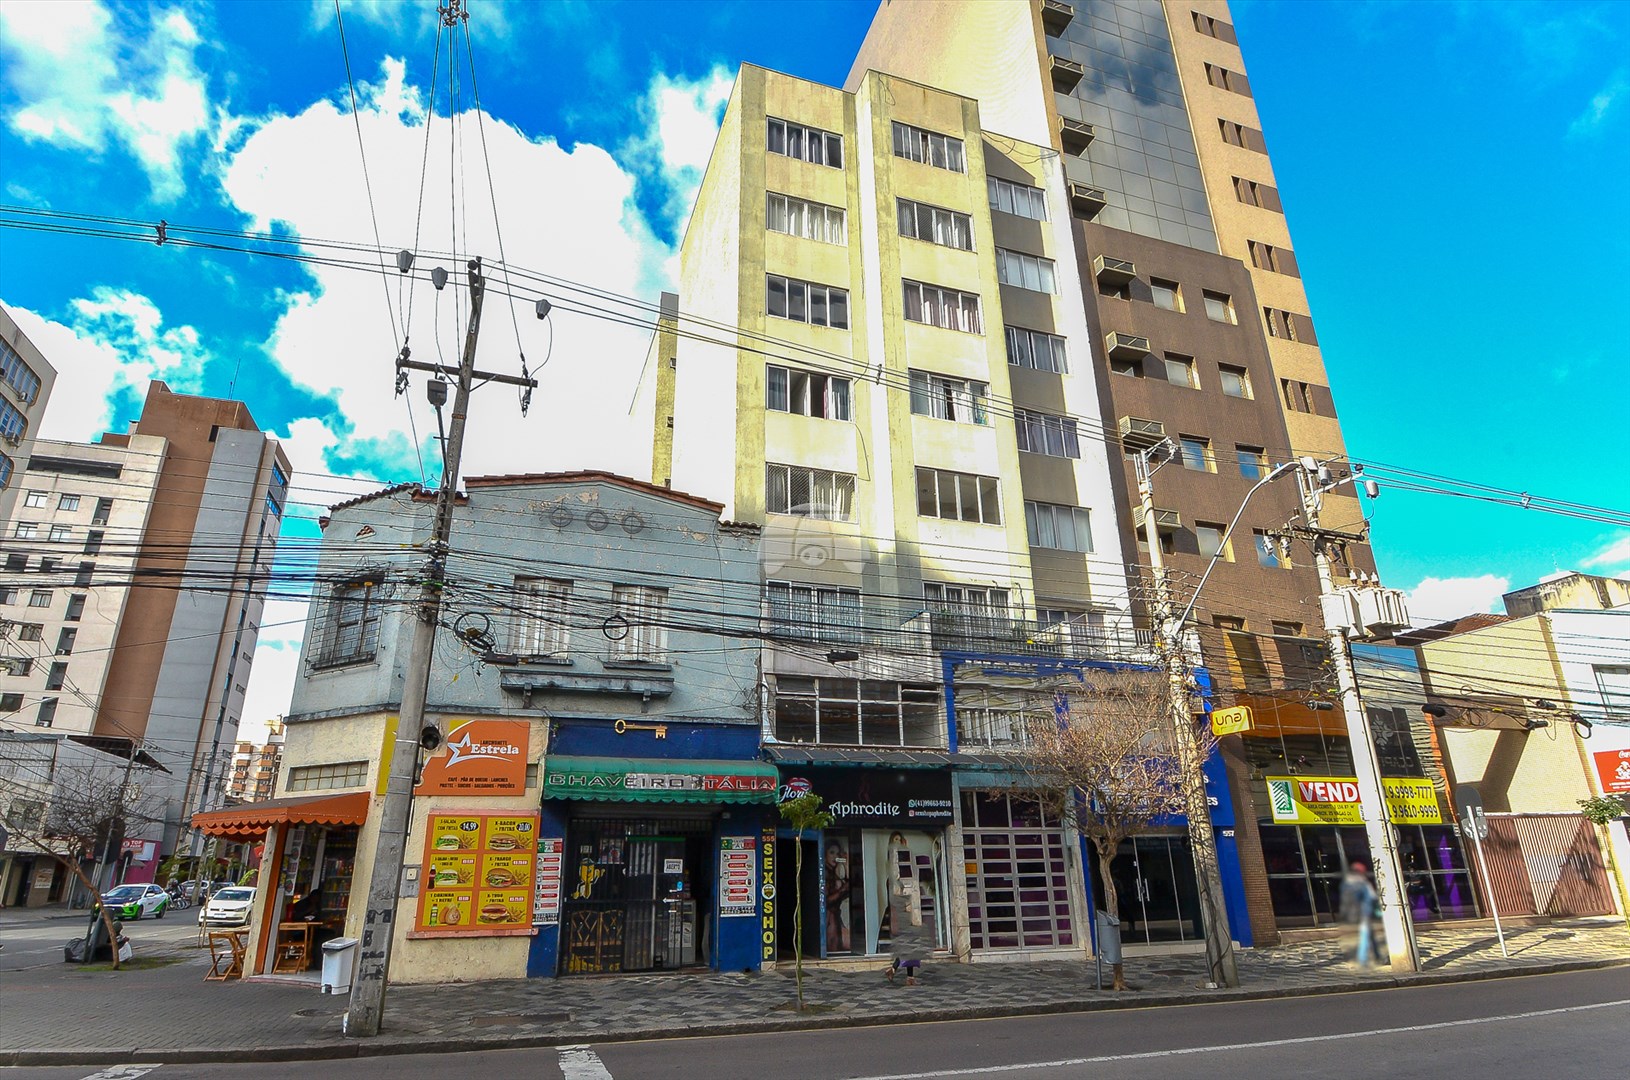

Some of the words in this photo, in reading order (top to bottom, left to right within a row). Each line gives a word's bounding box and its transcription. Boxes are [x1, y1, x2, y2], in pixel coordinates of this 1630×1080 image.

[470, 743, 519, 754] Estrela
[548, 773, 685, 789] CHAVEIRO
[697, 774, 775, 791] TÁLIA
[829, 801, 901, 817] Aphrodite
[1392, 804, 1439, 819] 9.9610-9999
[763, 843, 774, 884] SEX
[762, 901, 774, 959] SHOP
